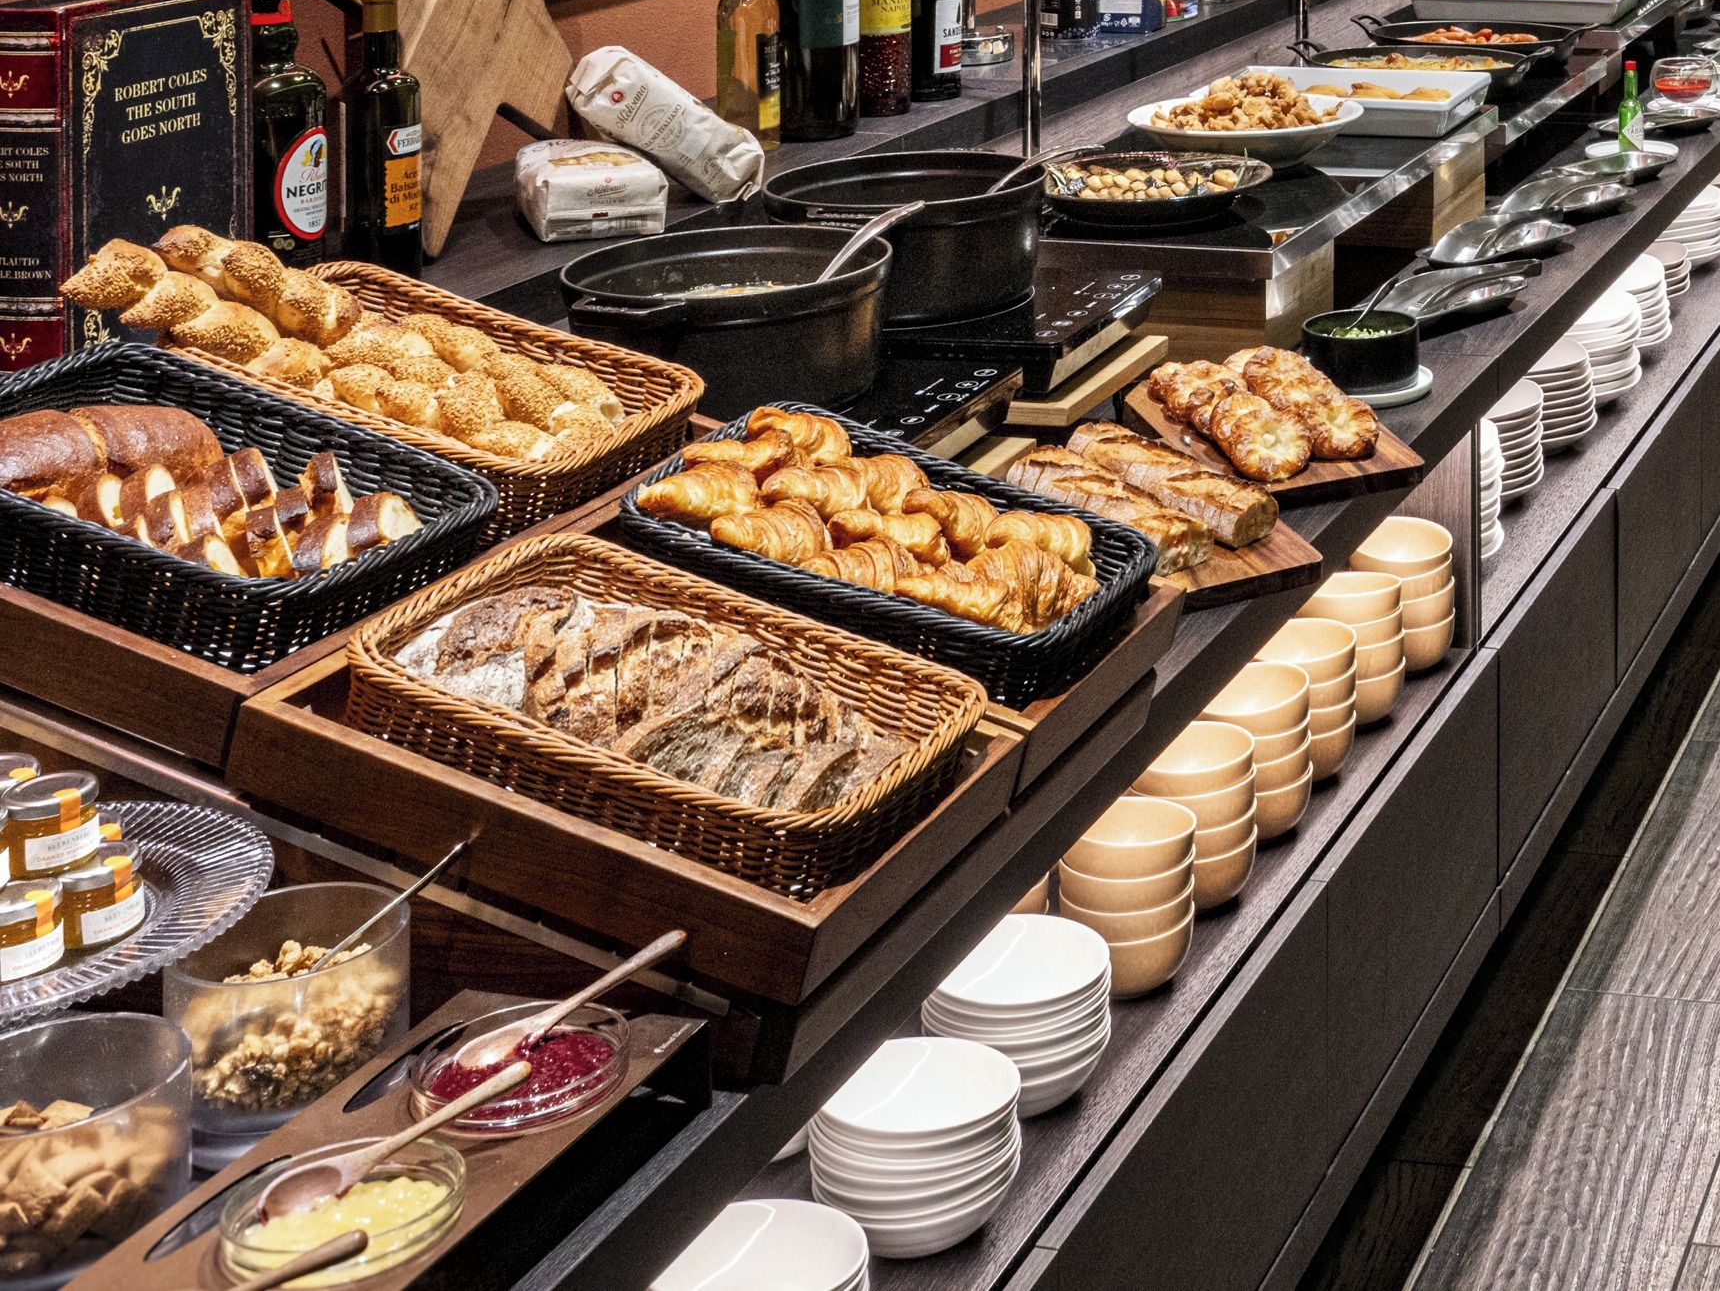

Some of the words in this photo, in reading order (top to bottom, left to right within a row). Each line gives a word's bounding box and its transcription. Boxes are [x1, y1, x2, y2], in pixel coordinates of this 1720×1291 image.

[114, 77, 166, 102] ROBERT
[169, 68, 208, 89] COLES
[126, 105, 152, 121] THE
[155, 93, 196, 114] SOUTH
[121, 125, 156, 144] GOES
[159, 112, 201, 135] NORTH
[659, 103, 682, 134] ITALIANO
[15, 147, 49, 156] COLES
[5, 160, 39, 169] SOUTH
[8, 173, 44, 182] NORTH
[286, 179, 327, 198] NEGRIT
[390, 195, 400, 204] di
